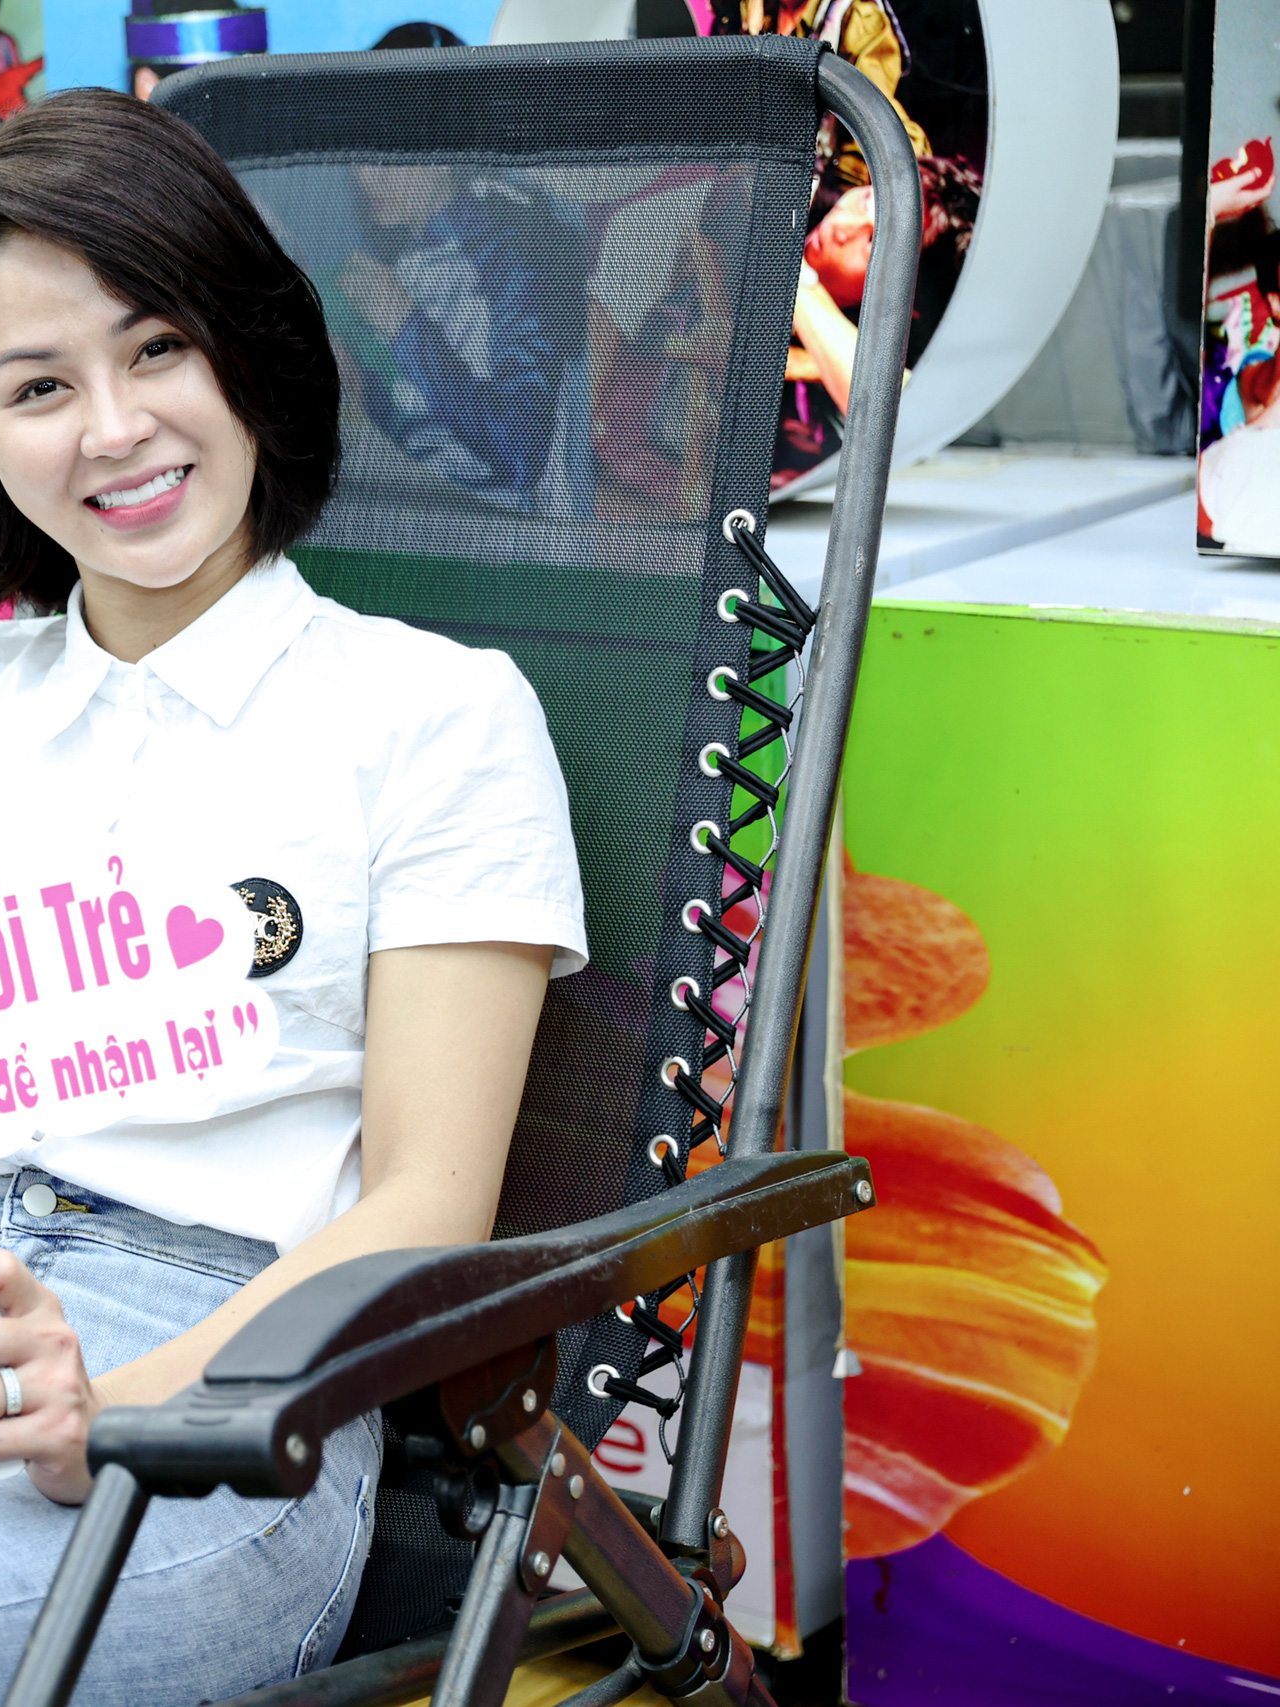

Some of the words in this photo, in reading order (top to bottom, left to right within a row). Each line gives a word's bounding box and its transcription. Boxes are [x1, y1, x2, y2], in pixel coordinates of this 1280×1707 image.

[40, 855, 151, 993] Trẻ
[51, 1034, 157, 1101] nhận
[165, 1008, 223, 1082] lại
